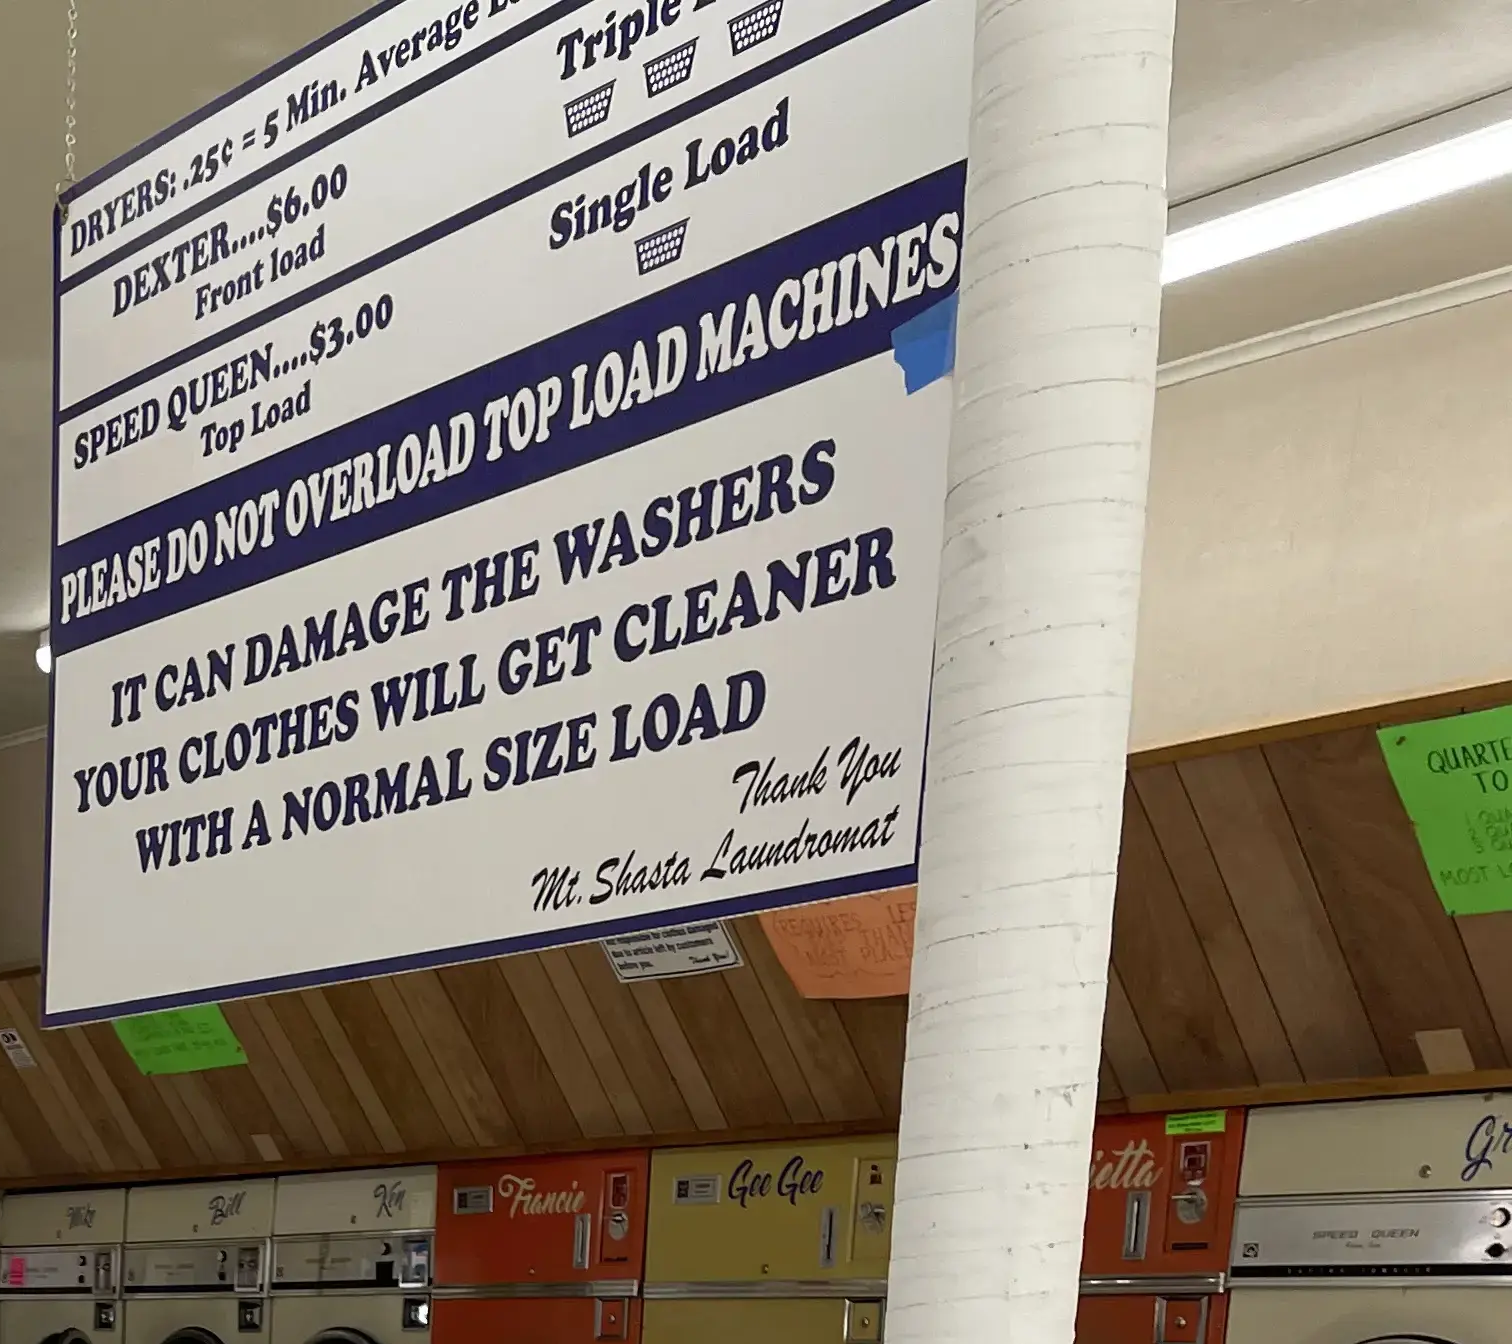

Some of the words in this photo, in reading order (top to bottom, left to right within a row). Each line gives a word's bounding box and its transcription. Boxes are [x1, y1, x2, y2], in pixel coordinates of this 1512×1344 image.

[556, 0, 681, 80] Triple
[70, 167, 177, 257] DRYERS:
[264, 109, 279, 149] 5
[285, 79, 347, 132] Min.
[354, 0, 480, 93] Average
[549, 162, 674, 249] Single
[684, 96, 789, 190] Load
[196, 258, 265, 320] Front
[270, 223, 326, 284] load
[59, 536, 162, 626] PLEASE
[165, 519, 210, 585] DO
[214, 488, 281, 566] NOT
[285, 411, 476, 538] OVERLOAD
[485, 375, 563, 462] TOP
[568, 325, 689, 430] LOAD
[695, 212, 960, 382] MACHINES
[72, 396, 161, 470] SPEED
[199, 420, 245, 458] Top
[251, 379, 312, 435] Load
[110, 673, 147, 727] IT
[154, 643, 236, 712] CAN
[243, 577, 431, 687] DAMAGE
[441, 539, 540, 622] THE
[553, 437, 837, 586] WASHERS
[73, 746, 170, 814] YOUR
[178, 690, 361, 785] CLOTHES
[371, 652, 486, 732] WILL
[497, 615, 602, 697] GET
[613, 526, 898, 664] CLEANER
[134, 806, 235, 875] WITH
[242, 798, 273, 850] A
[282, 746, 474, 842] NORMAL
[483, 711, 598, 793] SIZE
[609, 668, 767, 763] LOAD
[732, 744, 831, 815] Thank
[838, 735, 903, 806] You
[1427, 737, 1512, 774] QUARTE
[531, 865, 582, 913] Mt.
[589, 849, 692, 905] Shasta
[699, 804, 901, 882] Laundromat
[728, 1159, 772, 1209] Gee
[777, 1155, 824, 1206] Gee
[1090, 1138, 1164, 1190] ietta
[208, 1191, 247, 1226] Bill
[1371, 1228, 1420, 1239] QUEEN
